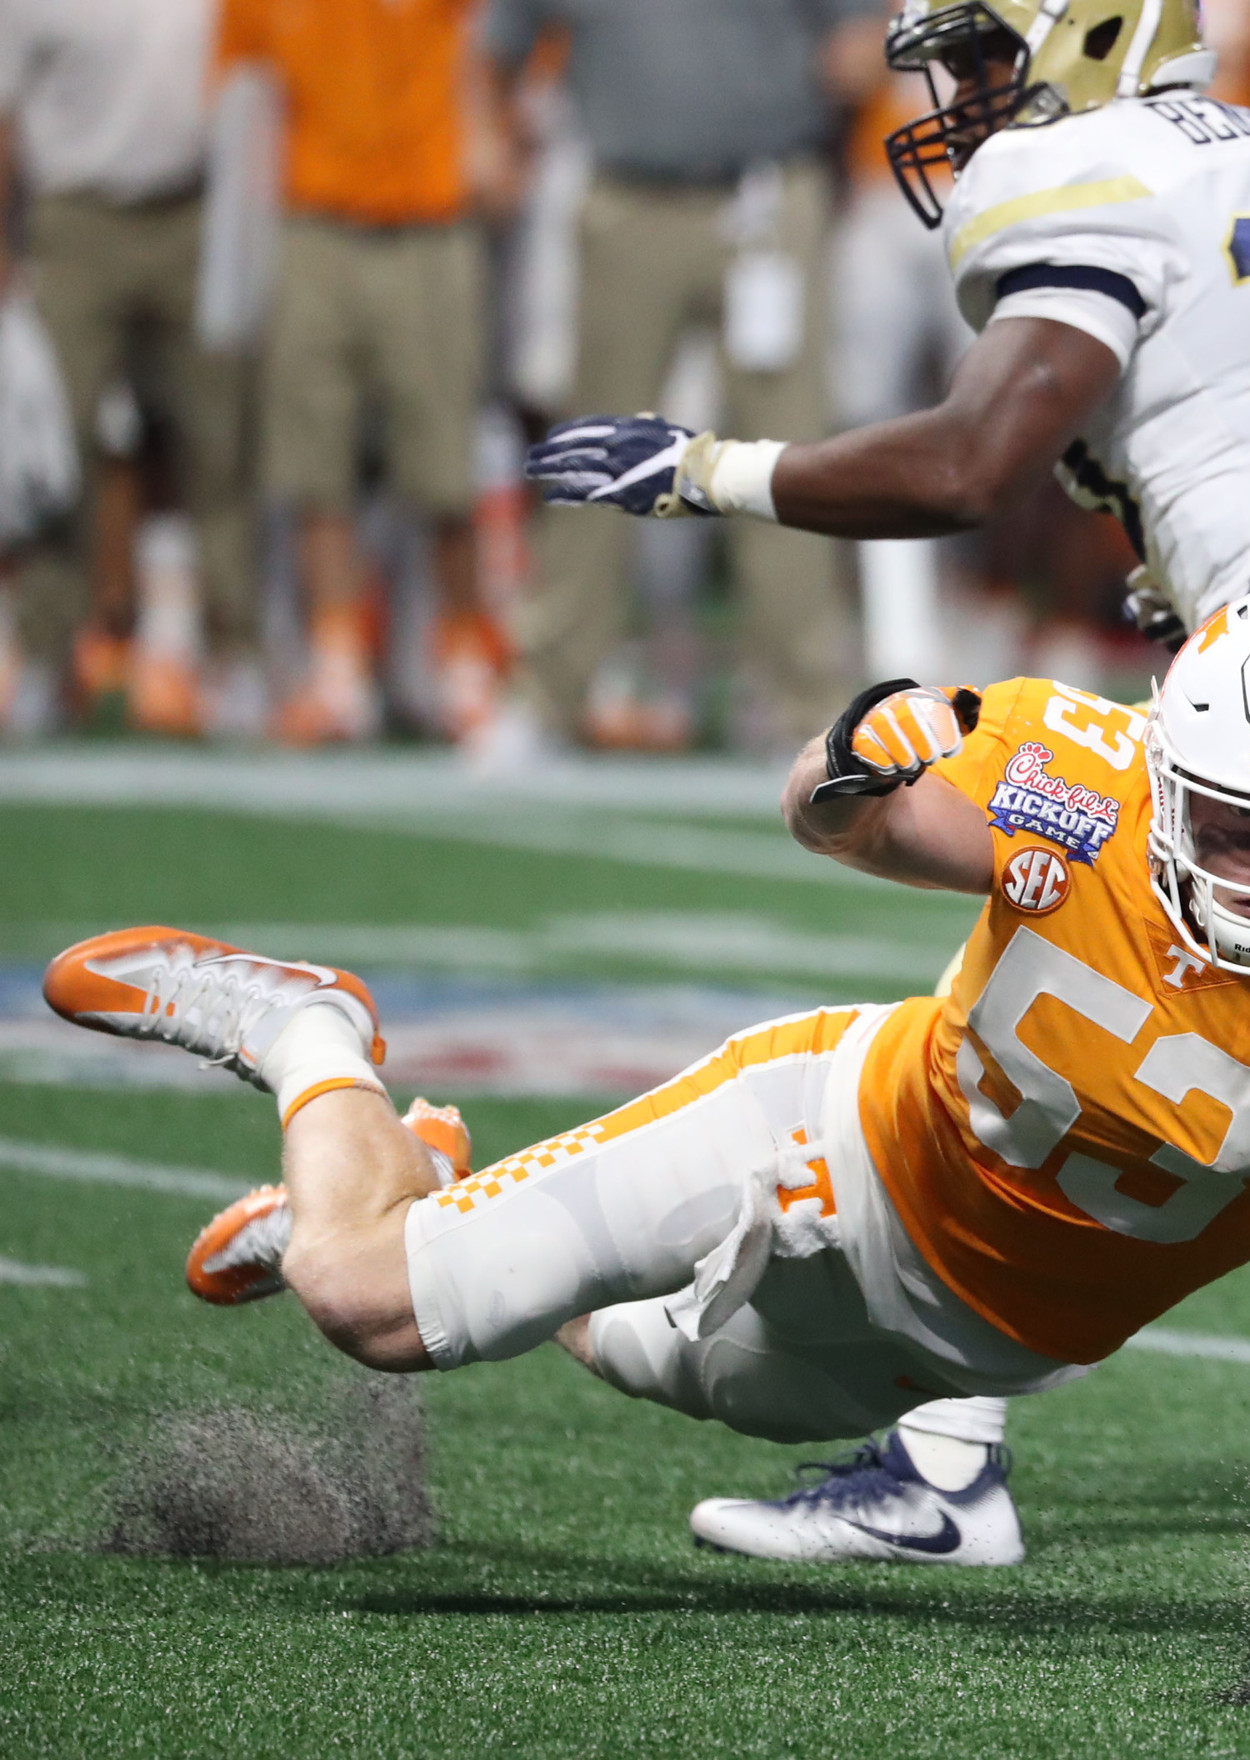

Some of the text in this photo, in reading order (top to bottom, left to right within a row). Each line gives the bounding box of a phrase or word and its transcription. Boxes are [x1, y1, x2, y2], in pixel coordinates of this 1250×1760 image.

[990, 783, 1115, 847] KICKOFF
[1007, 813, 1081, 850] GAME
[1004, 850, 1067, 910] SEC
